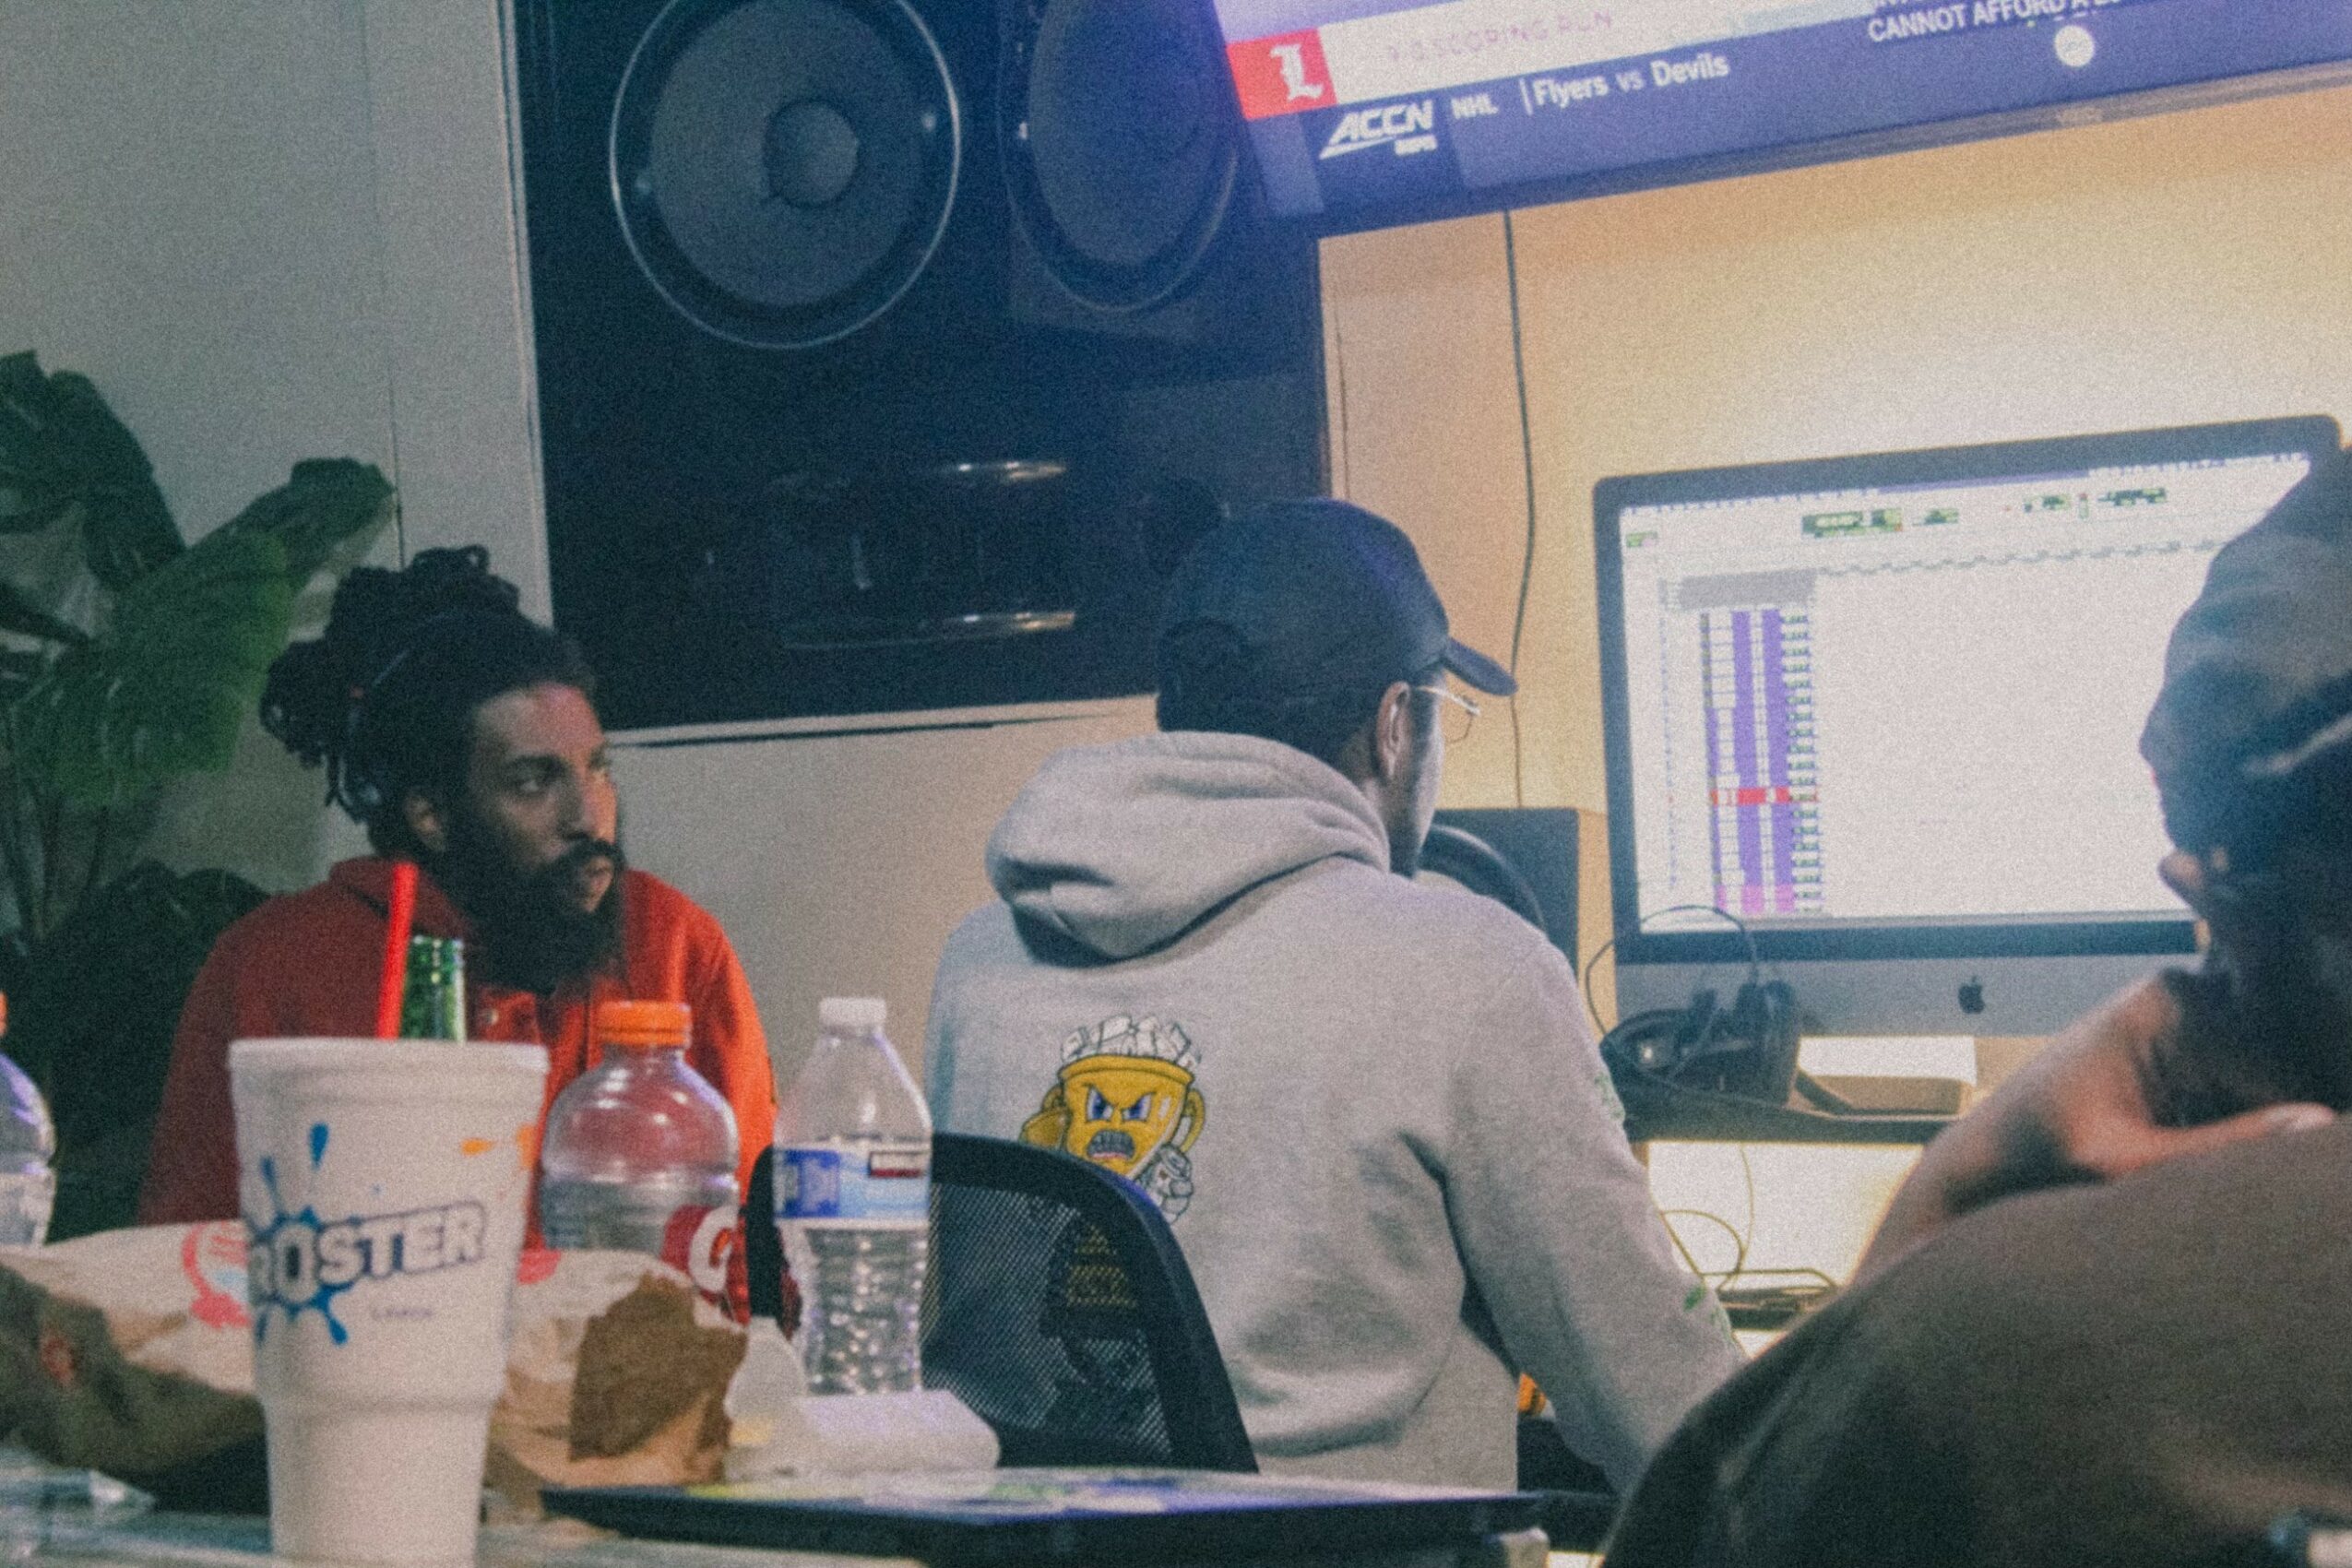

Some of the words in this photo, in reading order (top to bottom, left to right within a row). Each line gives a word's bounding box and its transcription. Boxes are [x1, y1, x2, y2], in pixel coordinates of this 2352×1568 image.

[1867, 4, 1966, 42] CANNOT
[1269, 42, 1324, 102] L
[1451, 94, 1500, 119] NHL
[1532, 76, 1609, 109] Flyers
[1615, 70, 1645, 92] vs
[1650, 52, 1729, 87] Devils
[1324, 99, 1433, 148] ACCN
